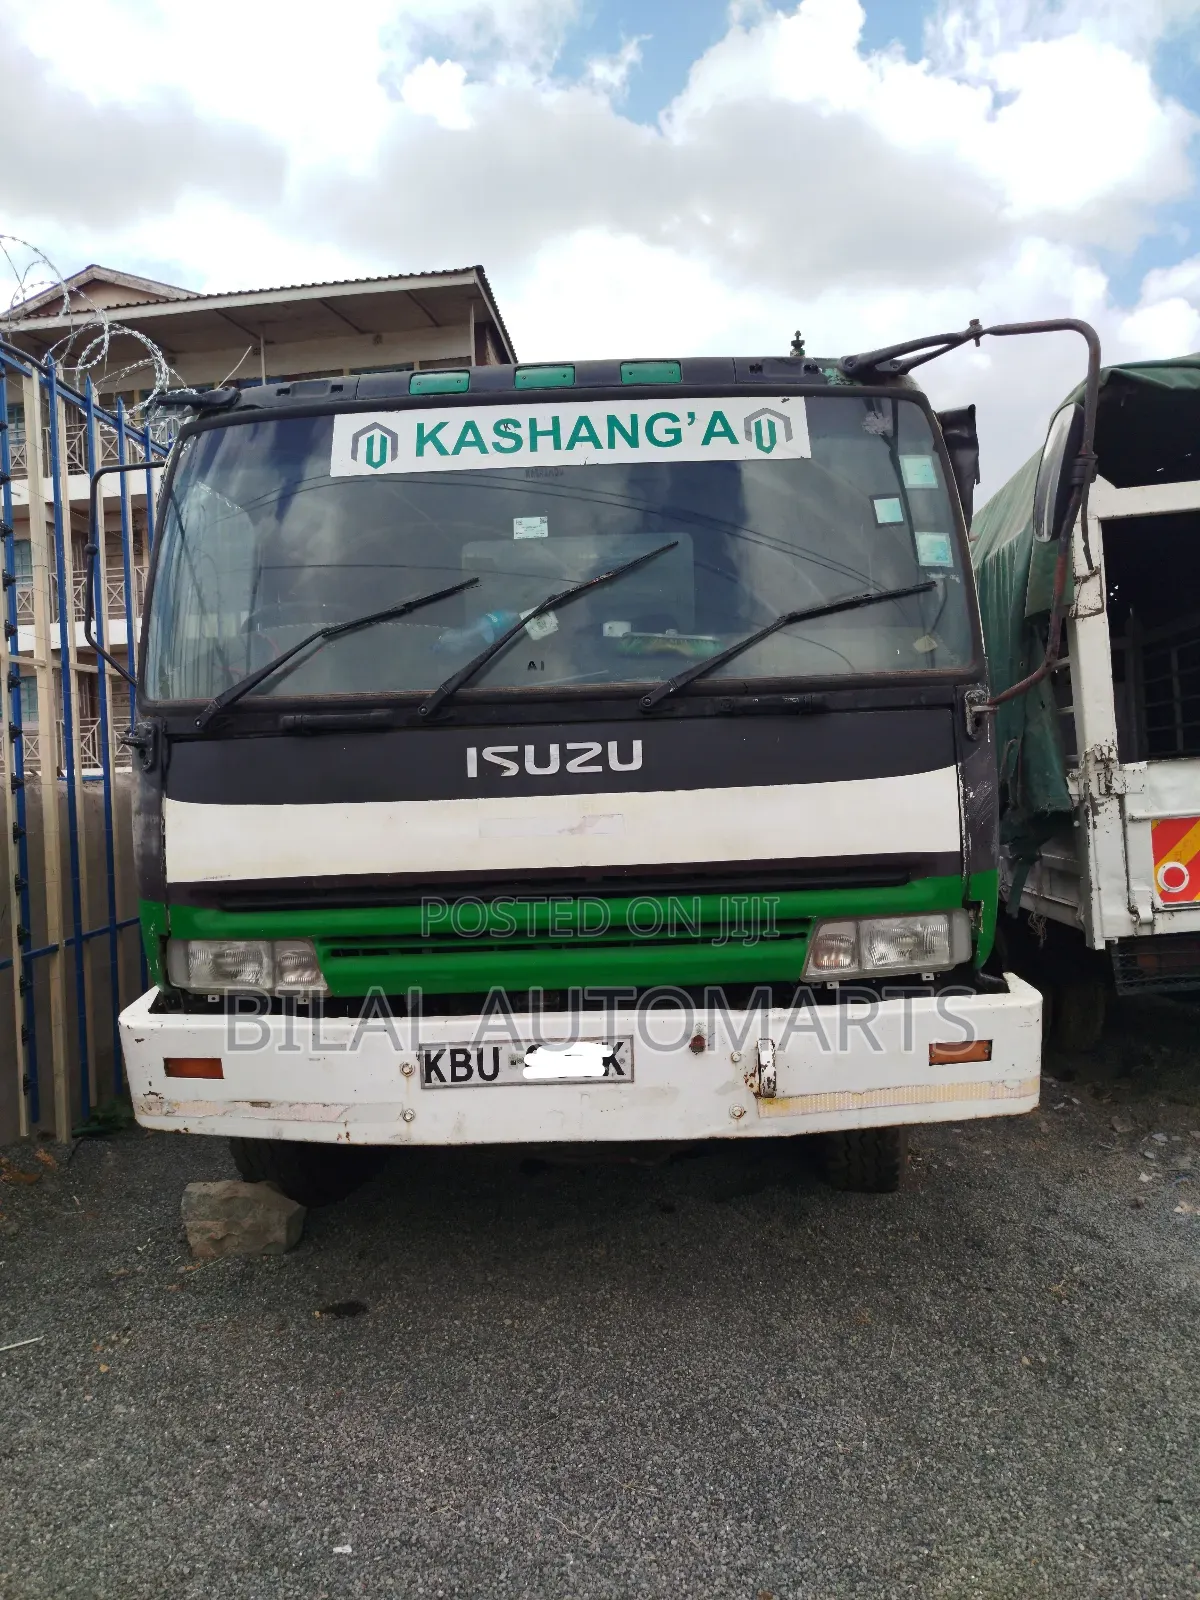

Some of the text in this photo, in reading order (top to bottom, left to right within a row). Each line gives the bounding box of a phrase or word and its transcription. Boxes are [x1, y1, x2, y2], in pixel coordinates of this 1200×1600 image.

[416, 410, 739, 457] KASHANG'A
[467, 740, 642, 777] ISUZU
[424, 1046, 500, 1083] KBU
